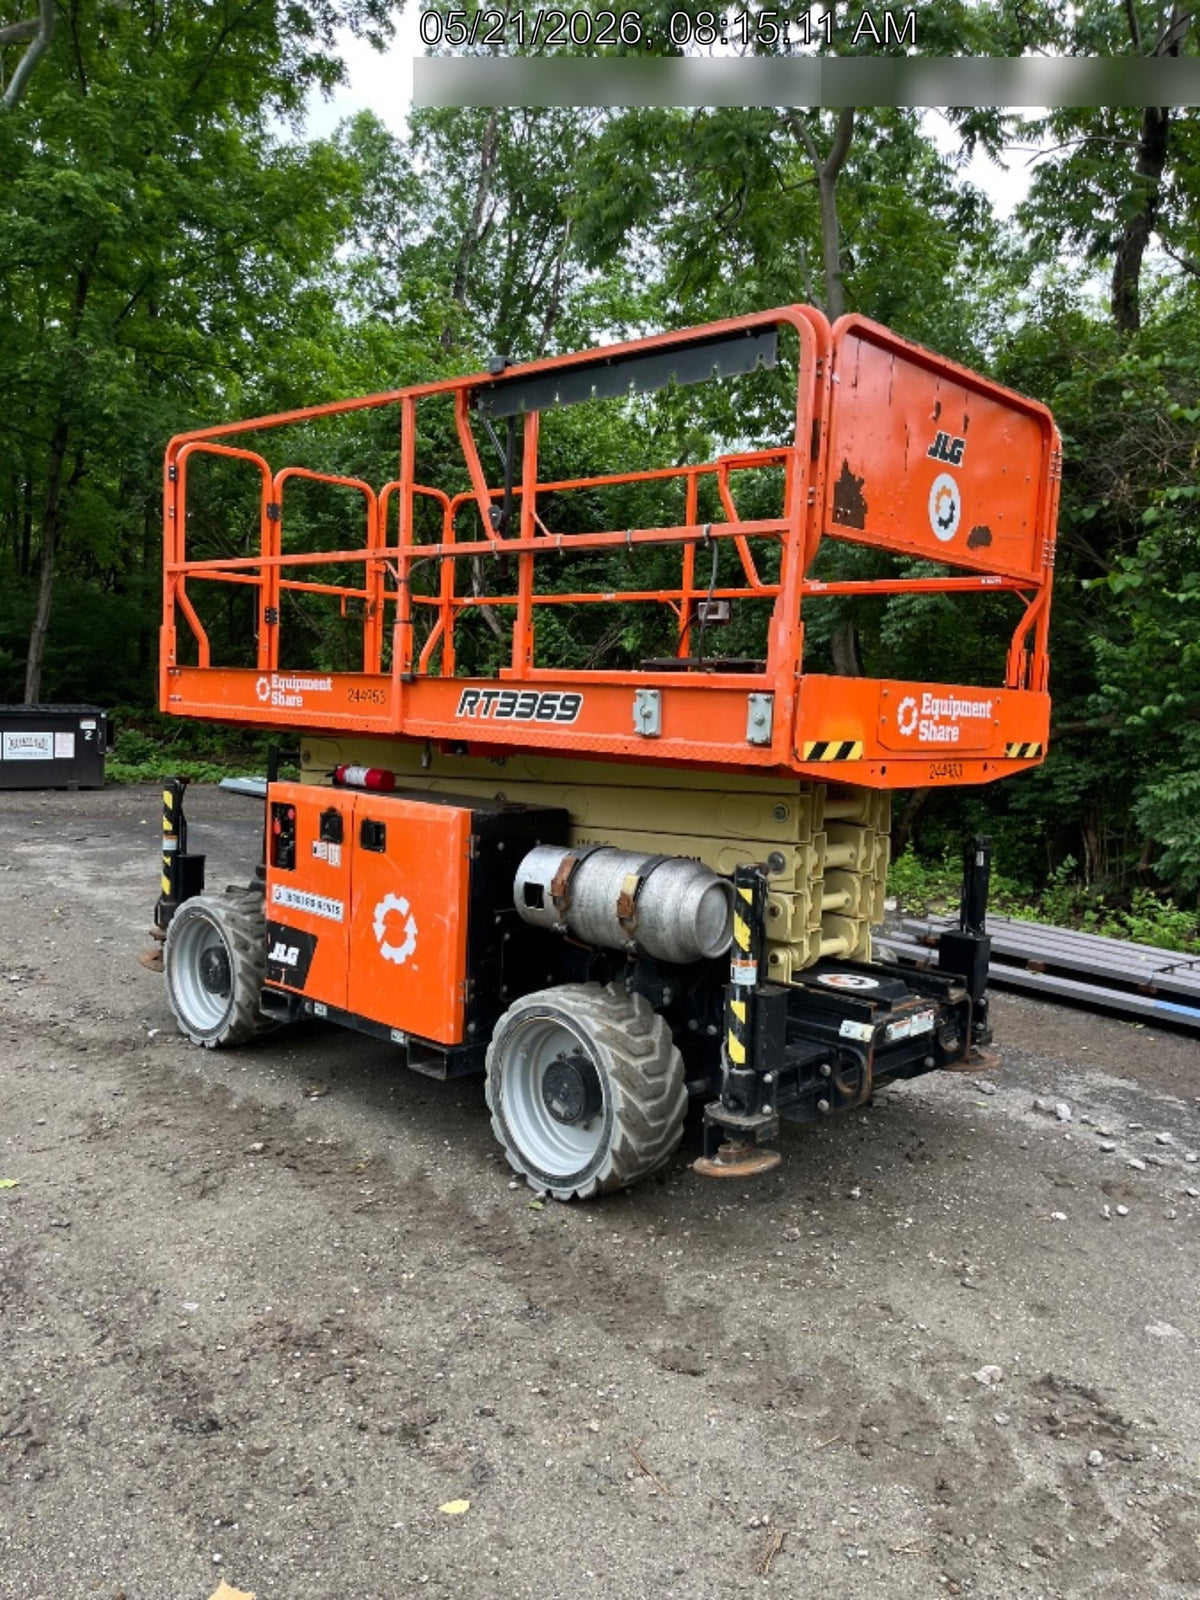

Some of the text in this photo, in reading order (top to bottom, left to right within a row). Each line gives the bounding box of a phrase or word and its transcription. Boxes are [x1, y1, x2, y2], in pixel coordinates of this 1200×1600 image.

[926, 430, 967, 467] JLG
[271, 674, 332, 692] Equipment
[271, 691, 303, 707] Share
[455, 688, 583, 723] RT3369
[920, 692, 993, 720] Equipment
[84, 730, 93, 740] 2
[918, 719, 960, 742] Share
[268, 941, 300, 966] JLG
